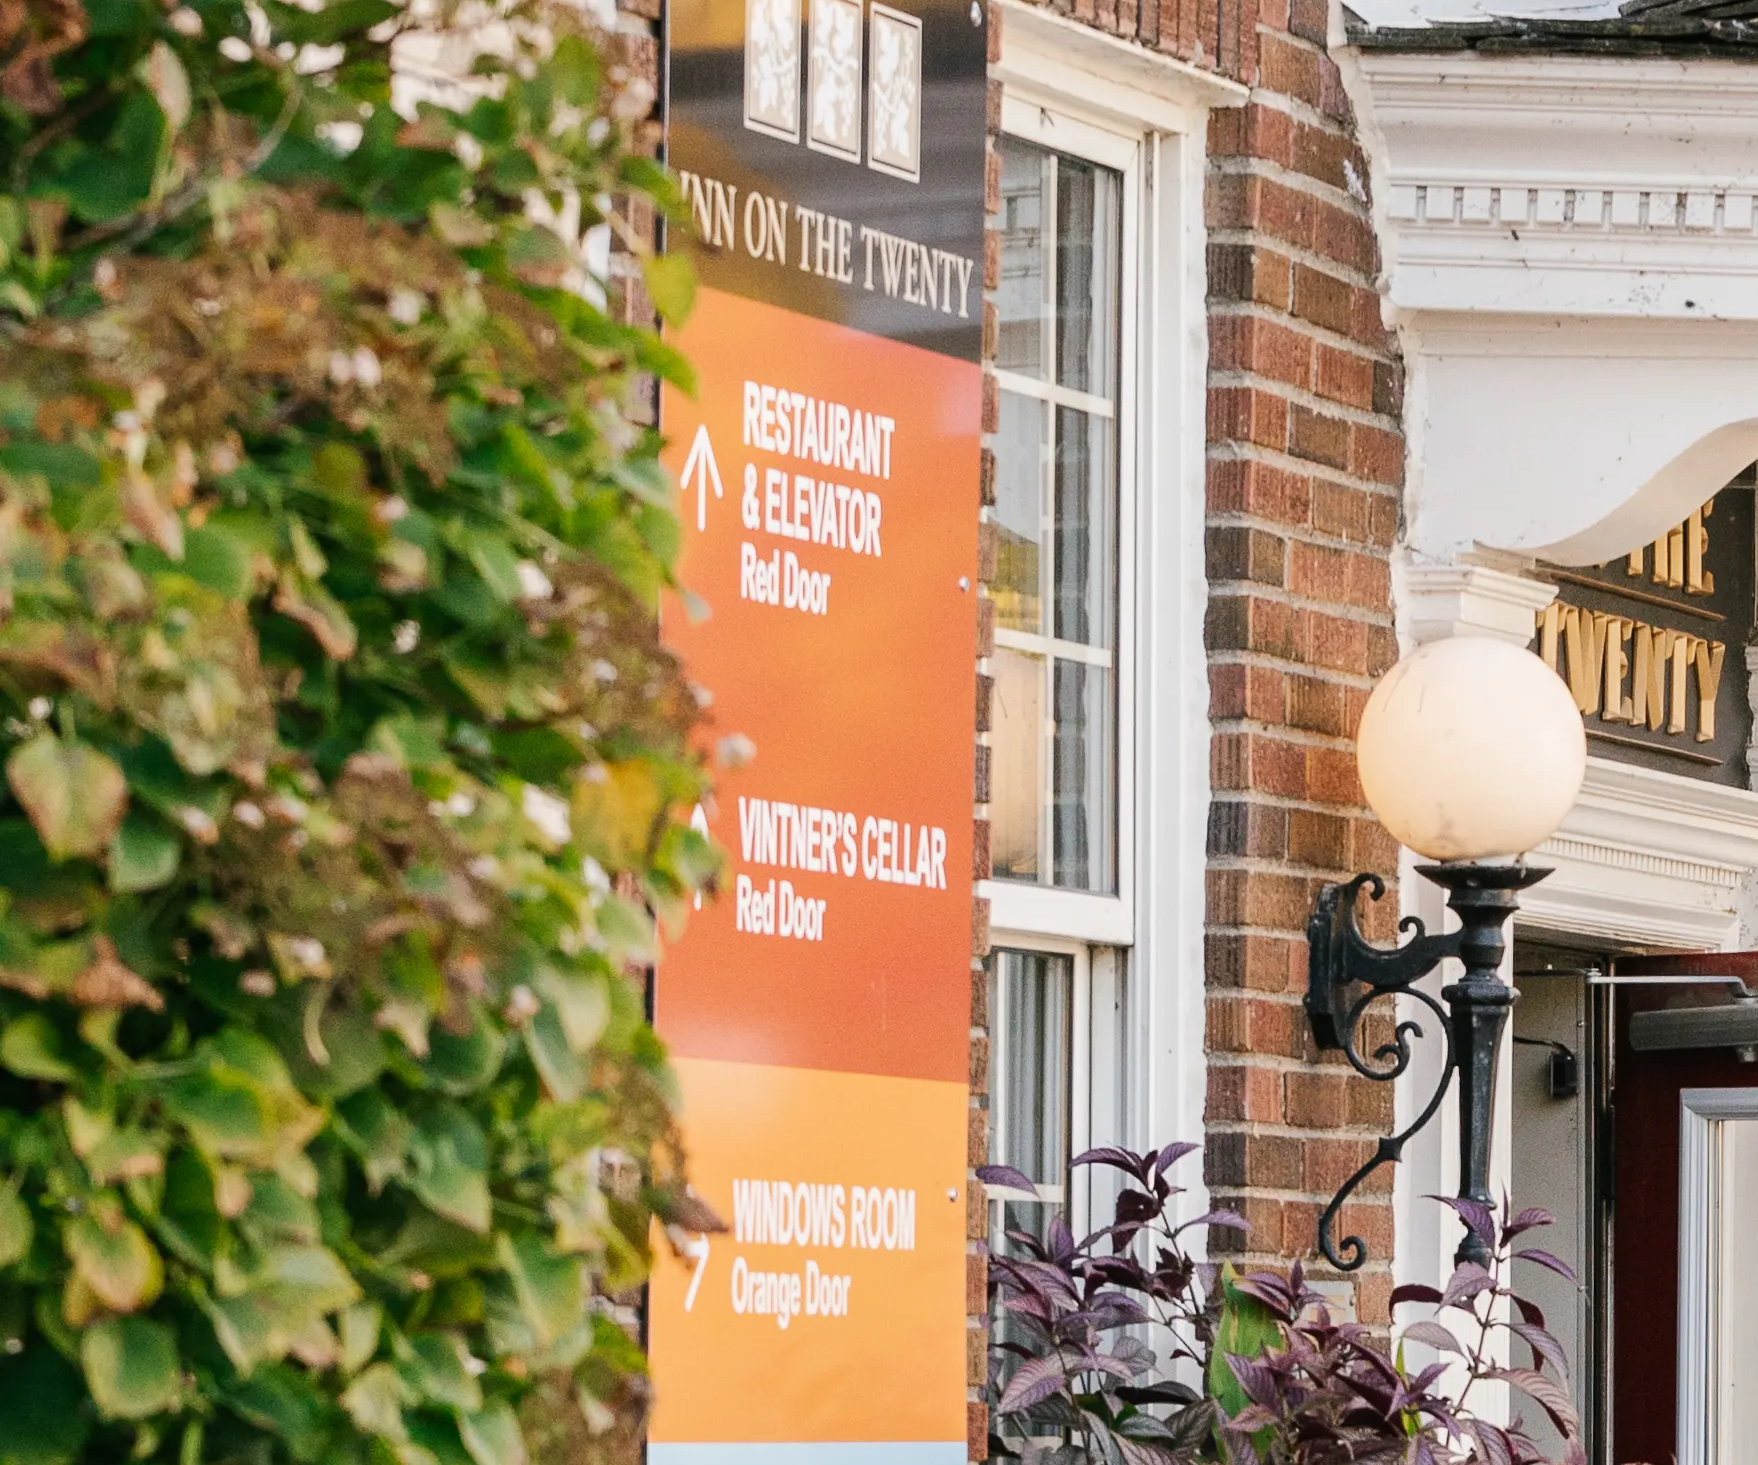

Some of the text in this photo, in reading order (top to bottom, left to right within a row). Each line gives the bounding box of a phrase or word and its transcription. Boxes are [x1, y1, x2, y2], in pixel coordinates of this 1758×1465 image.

[744, 191, 788, 265] ON
[795, 206, 854, 284] THE
[860, 225, 974, 318] TWENTY
[743, 380, 895, 480] RESTAURANT
[742, 463, 883, 558] & ELEVATOR
[740, 542, 831, 615] Red Door
[738, 796, 947, 890] VINTNER'S CELLAR
[736, 874, 826, 941] Red Door
[733, 1178, 916, 1250] WINDOWS ROOM
[732, 1256, 851, 1330] Orange Door
